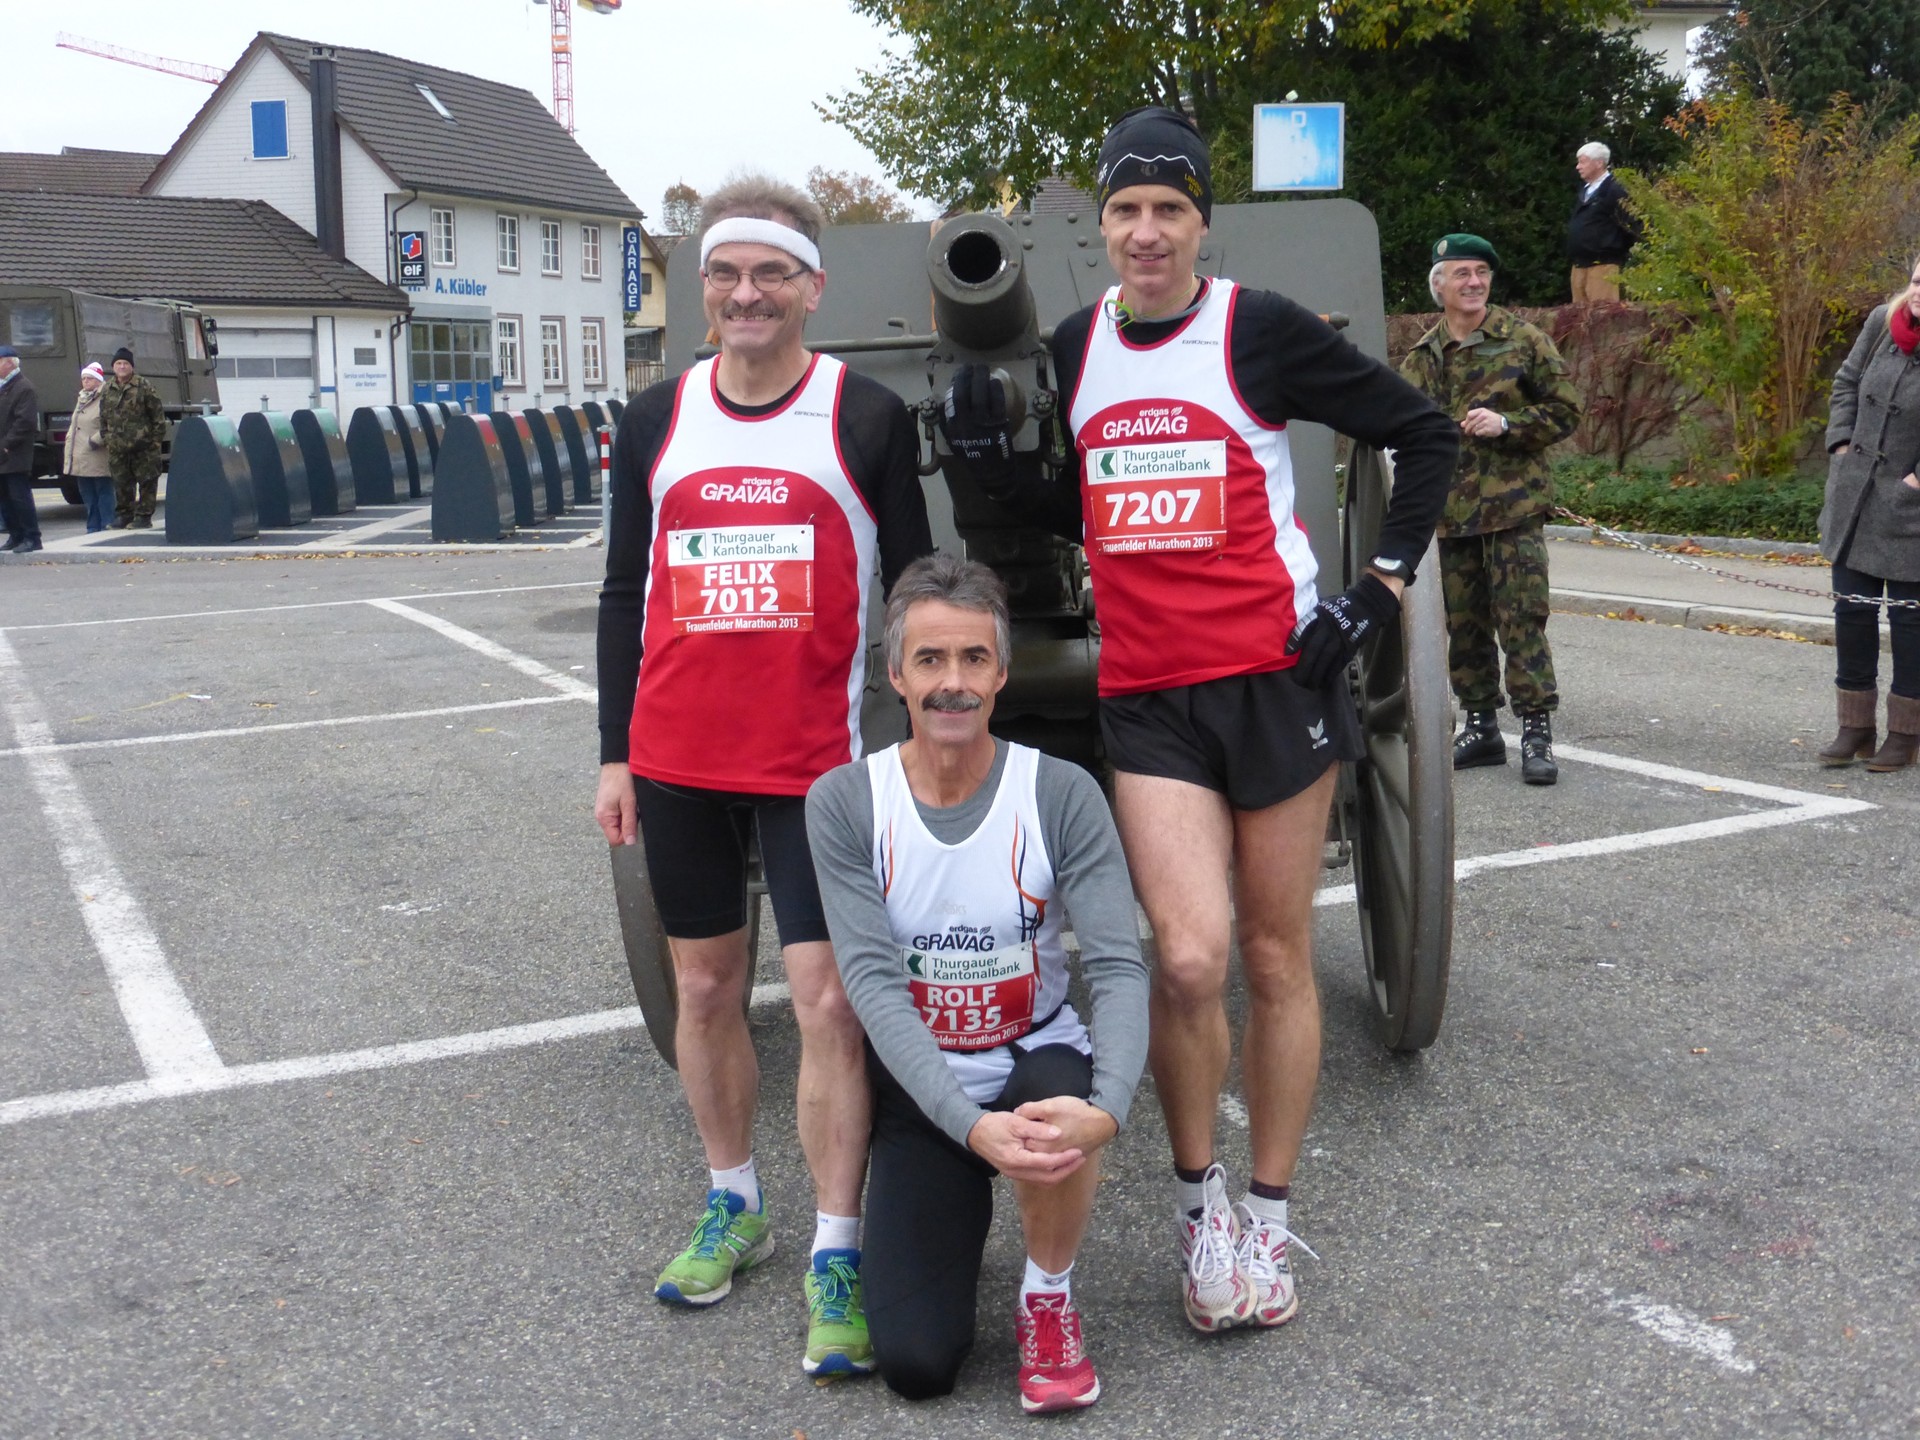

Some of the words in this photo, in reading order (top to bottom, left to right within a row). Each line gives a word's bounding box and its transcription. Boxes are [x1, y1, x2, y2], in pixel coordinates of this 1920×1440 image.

[403, 264, 423, 276] elf
[626, 231, 638, 308] GARAGE
[435, 277, 448, 294] A.
[449, 278, 488, 296] Kübler
[1139, 407, 1169, 417] erdgas
[1102, 415, 1189, 440] GRAVAG
[1122, 448, 1187, 462] Thurgauer
[1124, 458, 1211, 475] Kantonalbank
[742, 476, 772, 487] erdgas
[700, 482, 789, 504] GRAVAG
[1105, 488, 1201, 527] 7207
[711, 532, 775, 546] Thurgauer
[1148, 537, 1191, 550] Marathon
[1192, 536, 1213, 548] 2013
[713, 542, 799, 557] Kantonalbank
[704, 562, 775, 587] FELIX
[700, 586, 779, 615] 7012
[685, 619, 734, 632] Frauenfelder
[735, 617, 777, 629] Marathon
[778, 617, 799, 629] 2013
[948, 924, 978, 933] erdgas
[912, 933, 995, 952] GRAVAG
[931, 956, 1000, 971] Thurgauer
[933, 961, 1021, 981] Kantonalbank
[927, 985, 997, 1007] ROLF
[922, 1005, 1002, 1031] 7135
[959, 1033, 1001, 1046] Marathon
[1001, 1024, 1019, 1040] 2013
